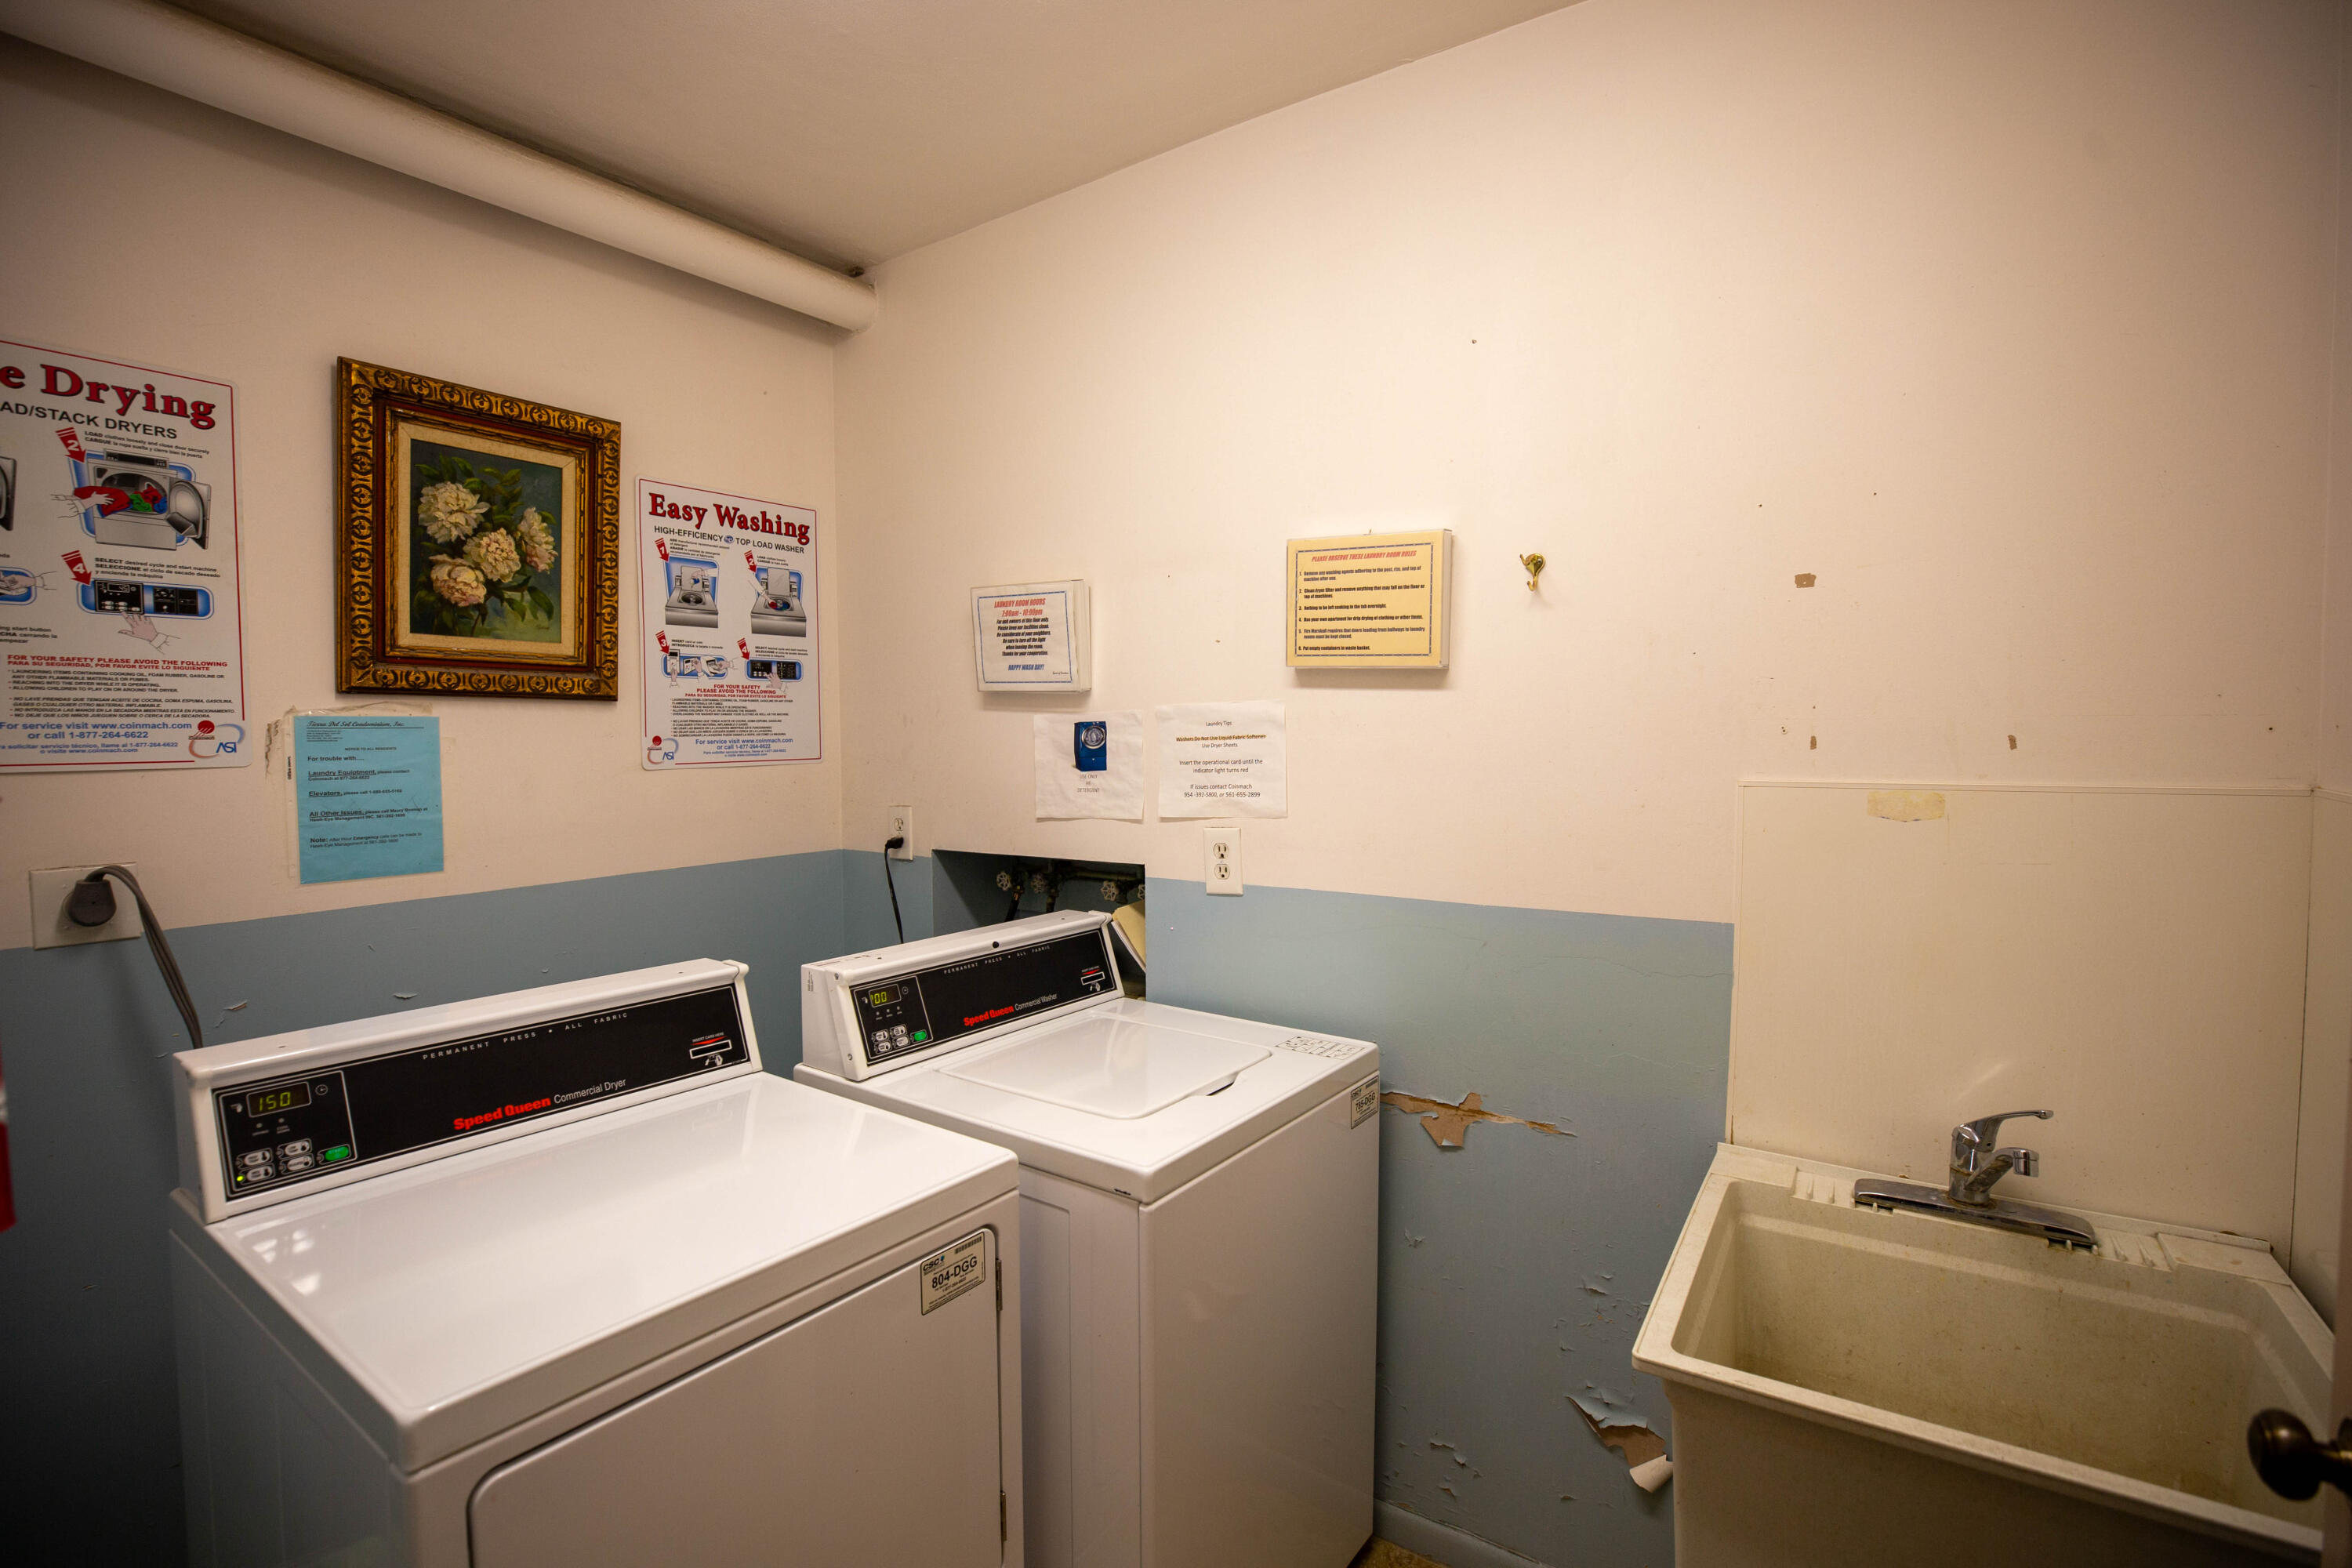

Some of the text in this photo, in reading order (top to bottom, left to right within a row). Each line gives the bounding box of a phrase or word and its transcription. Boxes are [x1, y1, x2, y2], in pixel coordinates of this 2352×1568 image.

[41, 364, 216, 430] Drying
[105, 418, 176, 439] DRYERS
[67, 440, 79, 452] 2
[648, 492, 809, 546] Easy Washing
[654, 525, 723, 543] HIGH-EFFICIENCY
[774, 543, 804, 554] WASHER
[72, 563, 85, 574] 4
[994, 600, 1014, 608] LAUNDRY
[65, 721, 87, 730] visit
[91, 721, 192, 730] www.coinmach.com
[943, 962, 978, 975] PERMANENT
[984, 956, 1002, 965] PRESS
[1031, 945, 1051, 953] FABRIC
[964, 993, 1058, 1027] Speed Queen Commercial Washer
[423, 1011, 628, 1060] PERMANENT PRESS ALL FABRIC
[259, 1091, 291, 1112] 150
[453, 1077, 626, 1133] Speed Queen Commercial Dryer
[923, 1258, 940, 1272] CSC
[931, 1256, 978, 1289] 804-DGG
